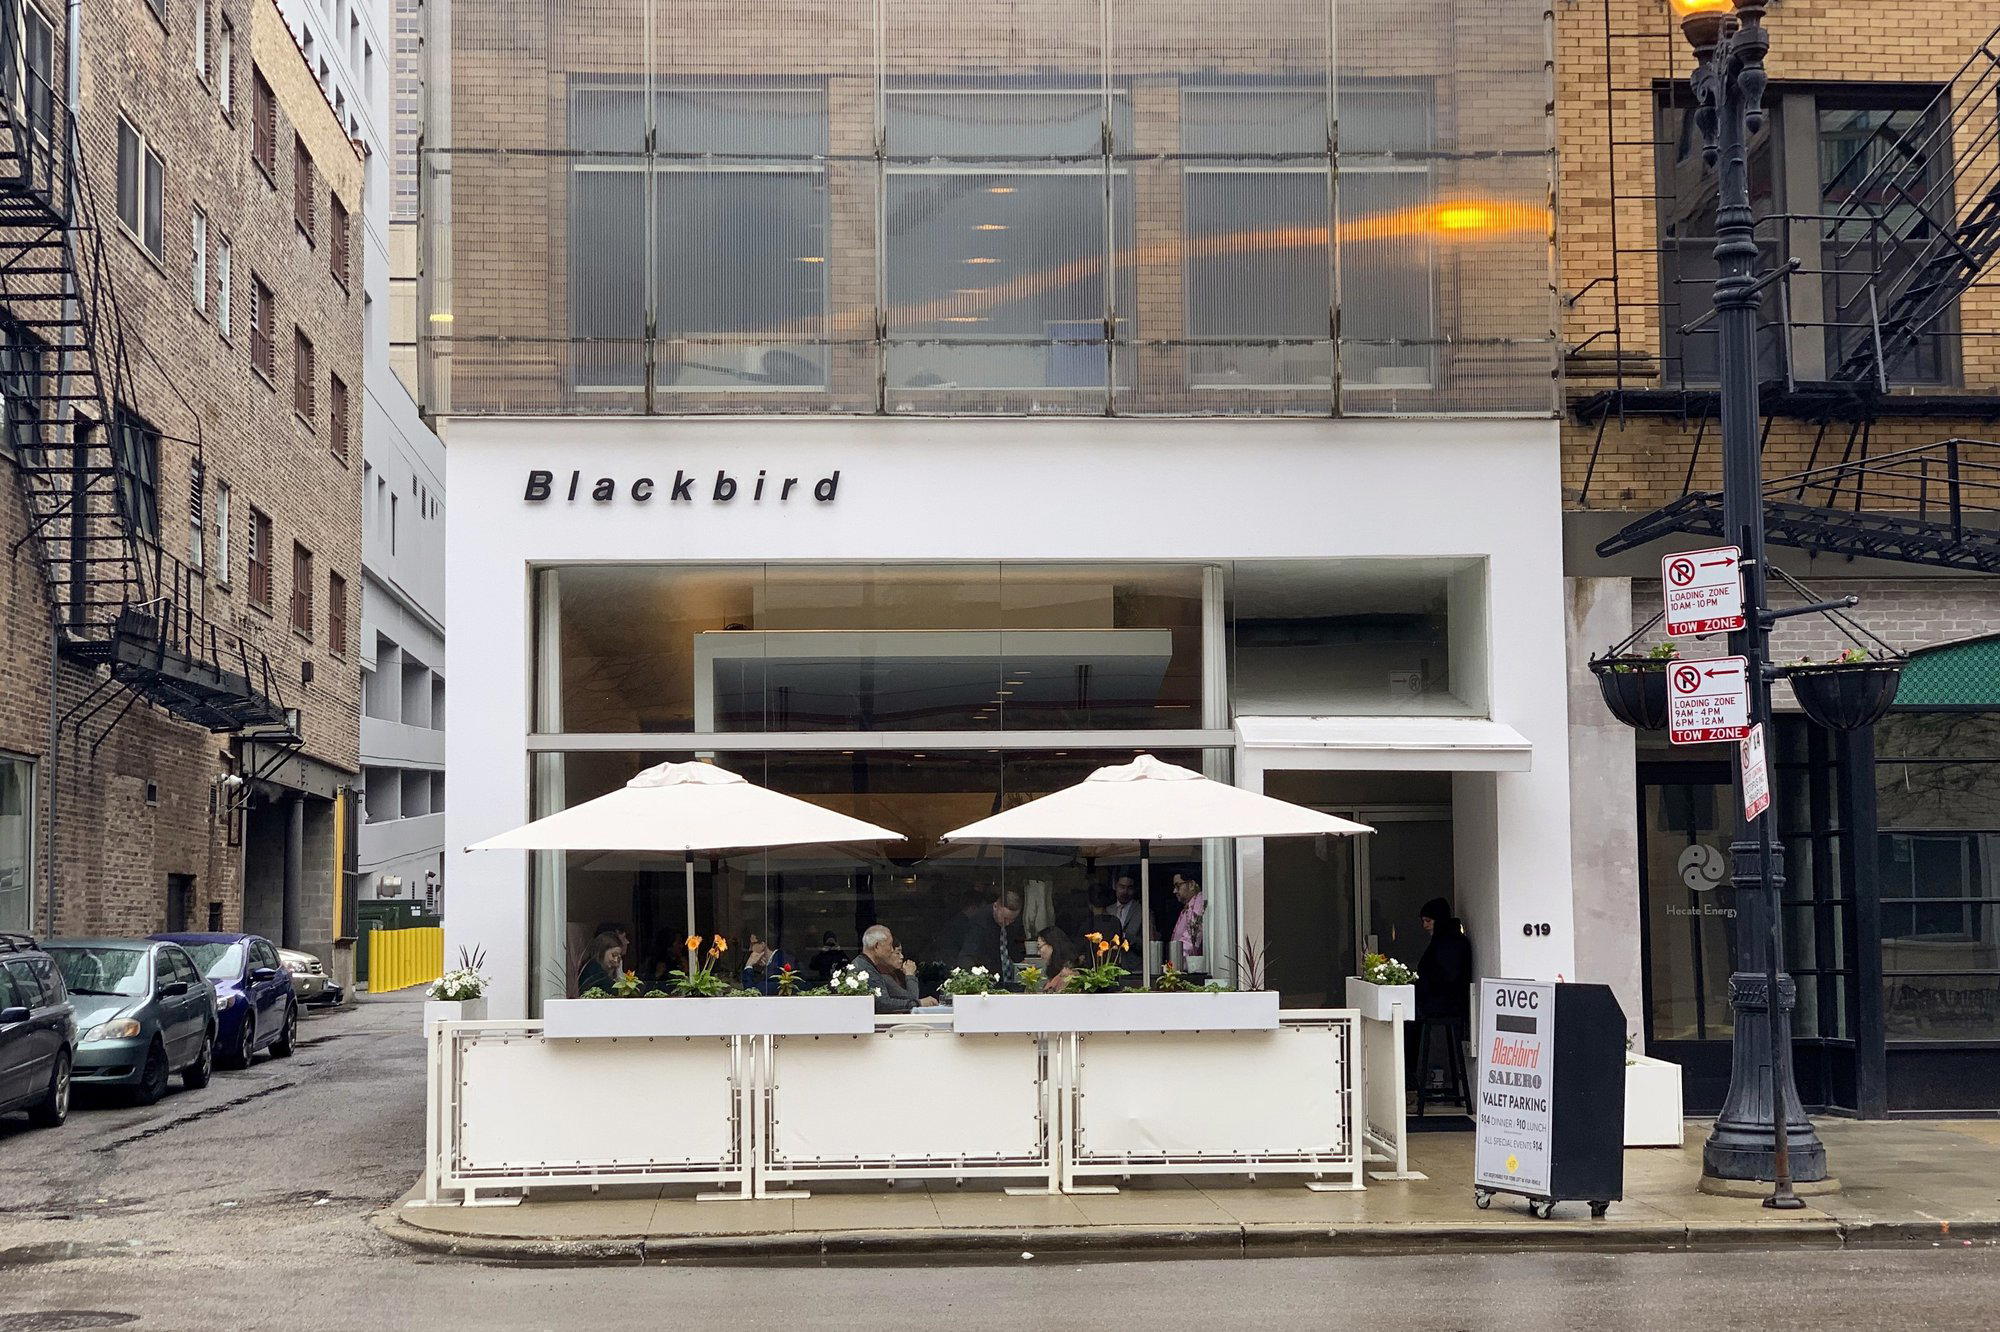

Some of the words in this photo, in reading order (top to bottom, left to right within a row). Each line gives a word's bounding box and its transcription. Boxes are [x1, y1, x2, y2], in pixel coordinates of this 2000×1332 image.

[524, 470, 840, 502] Blackbird
[1670, 590, 1704, 602] LOADING
[1709, 587, 1730, 597] ZONE
[1672, 622, 1698, 634] TOW
[1704, 617, 1738, 630] ZONE
[1674, 698, 1710, 709] LOADING
[1714, 697, 1736, 706] ZONE
[1676, 730, 1702, 741] TOW
[1709, 727, 1743, 739] ZONE
[1666, 904, 1701, 915] Hecate
[1704, 904, 1738, 918] Energy
[1523, 923, 1551, 937] 619
[1495, 988, 1539, 1010] avec
[1491, 1037, 1541, 1069] Blackbird
[1488, 1069, 1542, 1089] SALERO
[1482, 1091, 1507, 1108] VALET
[1508, 1095, 1547, 1112] PARKING
[1491, 1117, 1512, 1128] DINNER
[1527, 1122, 1547, 1133] LUNCH
[1484, 1136, 1493, 1145] ALL
[1493, 1137, 1513, 1148] SPECIAL
[1513, 1140, 1532, 1151] EVENTS
